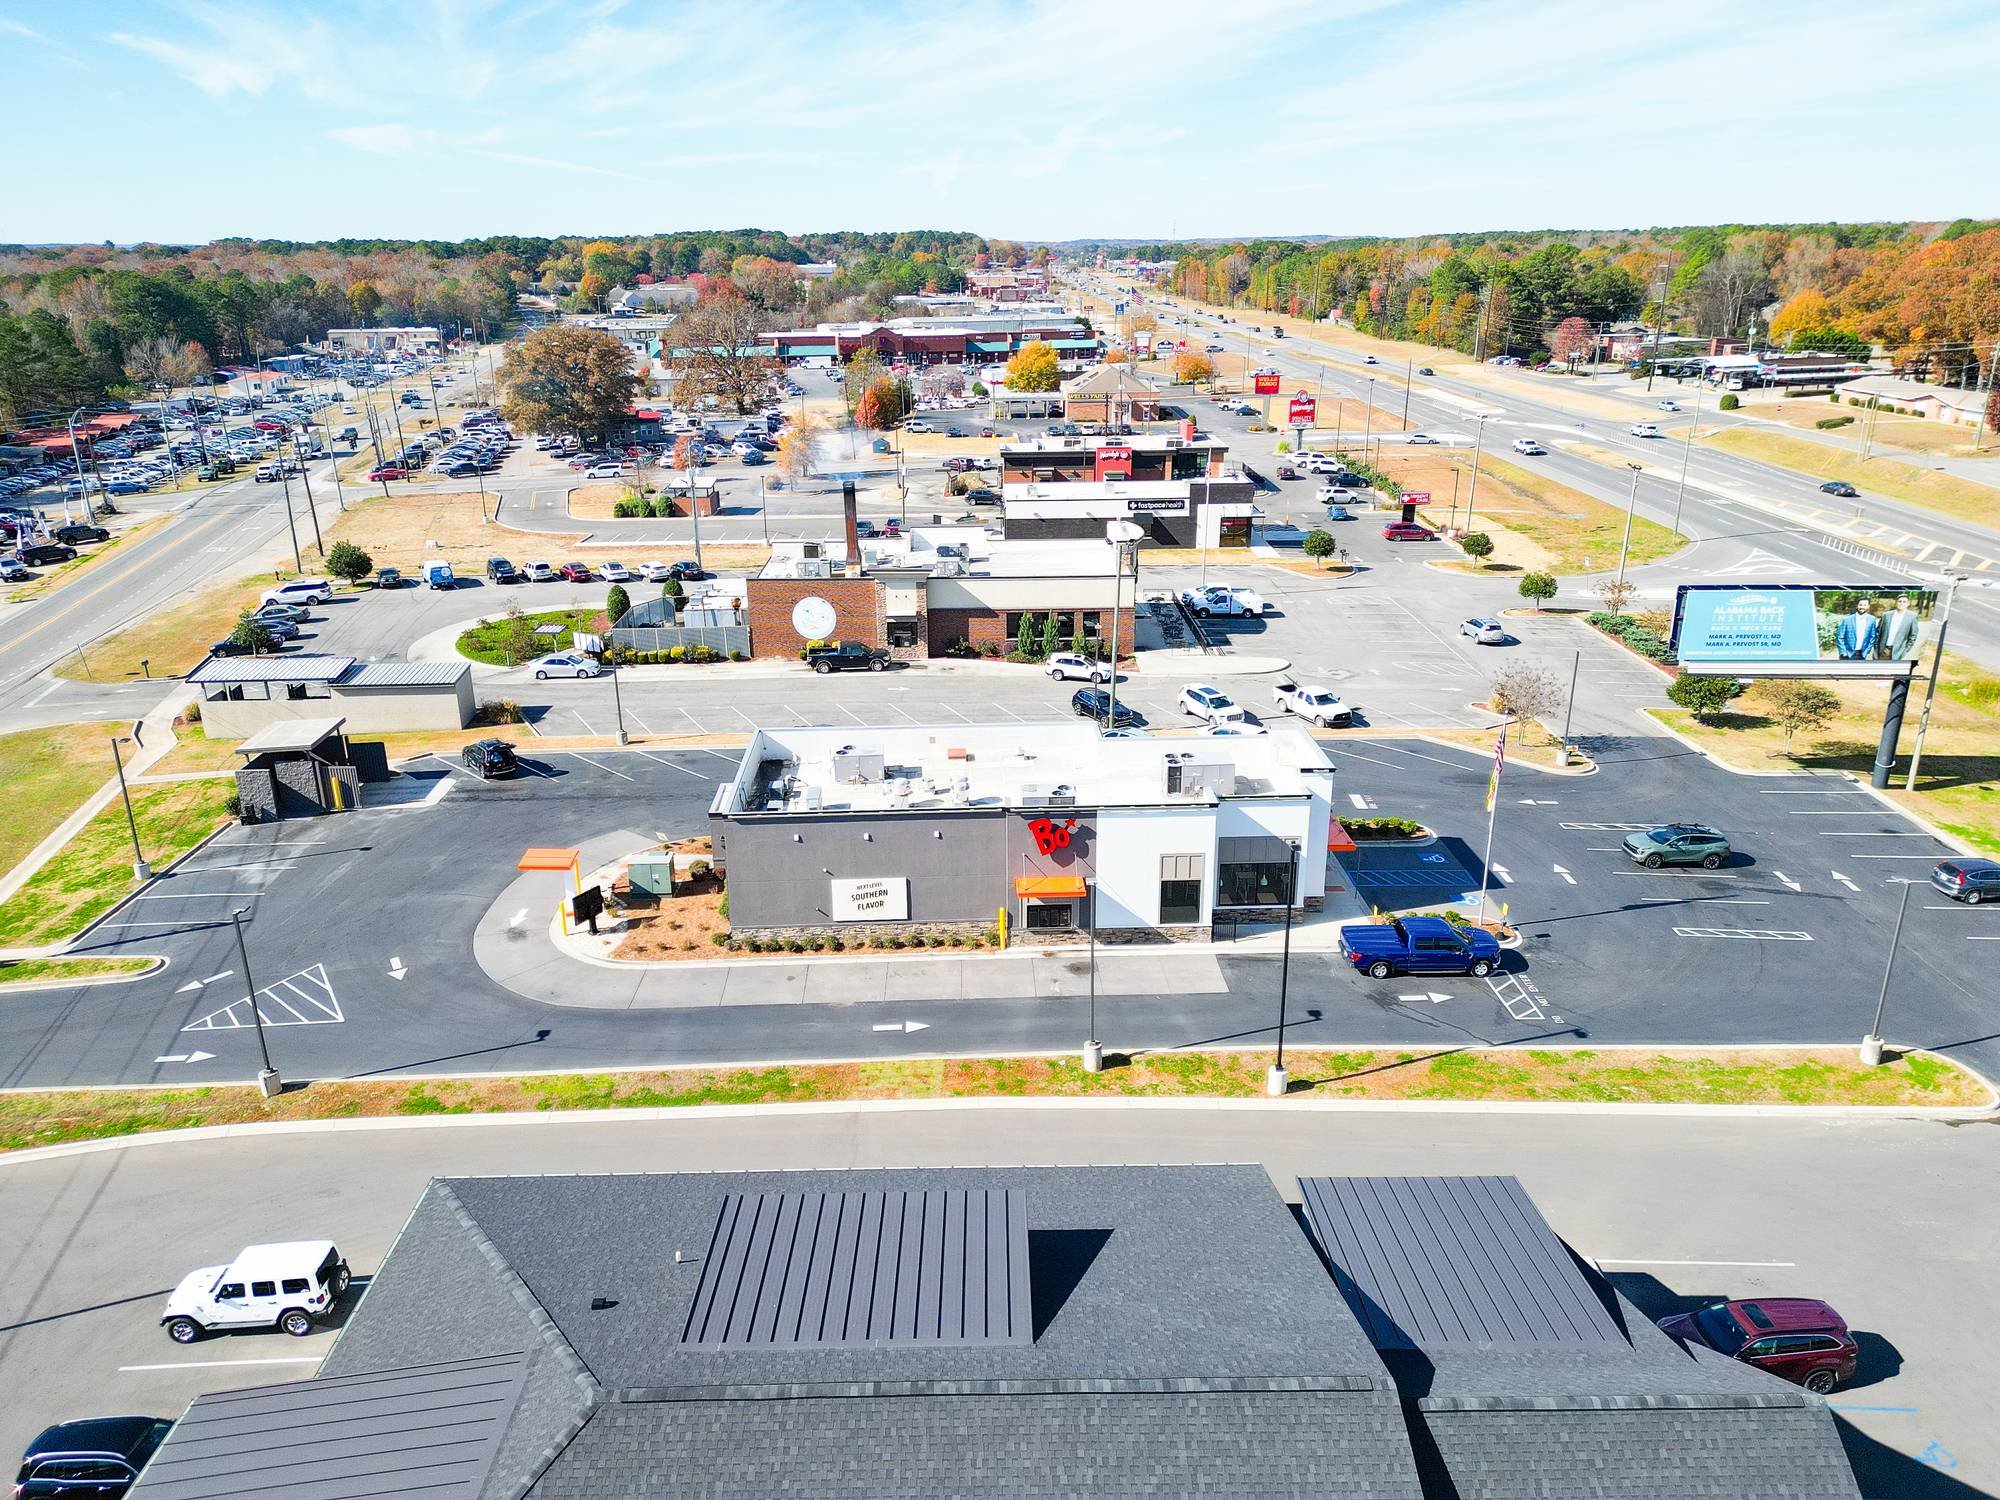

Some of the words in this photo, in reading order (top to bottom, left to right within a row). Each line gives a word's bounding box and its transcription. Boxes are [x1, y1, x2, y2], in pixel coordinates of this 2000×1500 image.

[1713, 606, 1758, 614] ALABAMA
[1760, 605, 1786, 614] BACK
[1711, 613, 1785, 623] INSTITUTE
[869, 881, 884, 889] LEVEL
[851, 889, 888, 902] SOUTHERN
[857, 900, 885, 911] FLAVOR
[1518, 974, 1539, 993] ENTER
[1534, 995, 1551, 1007] NOT
[1551, 1015, 1565, 1024] DO
